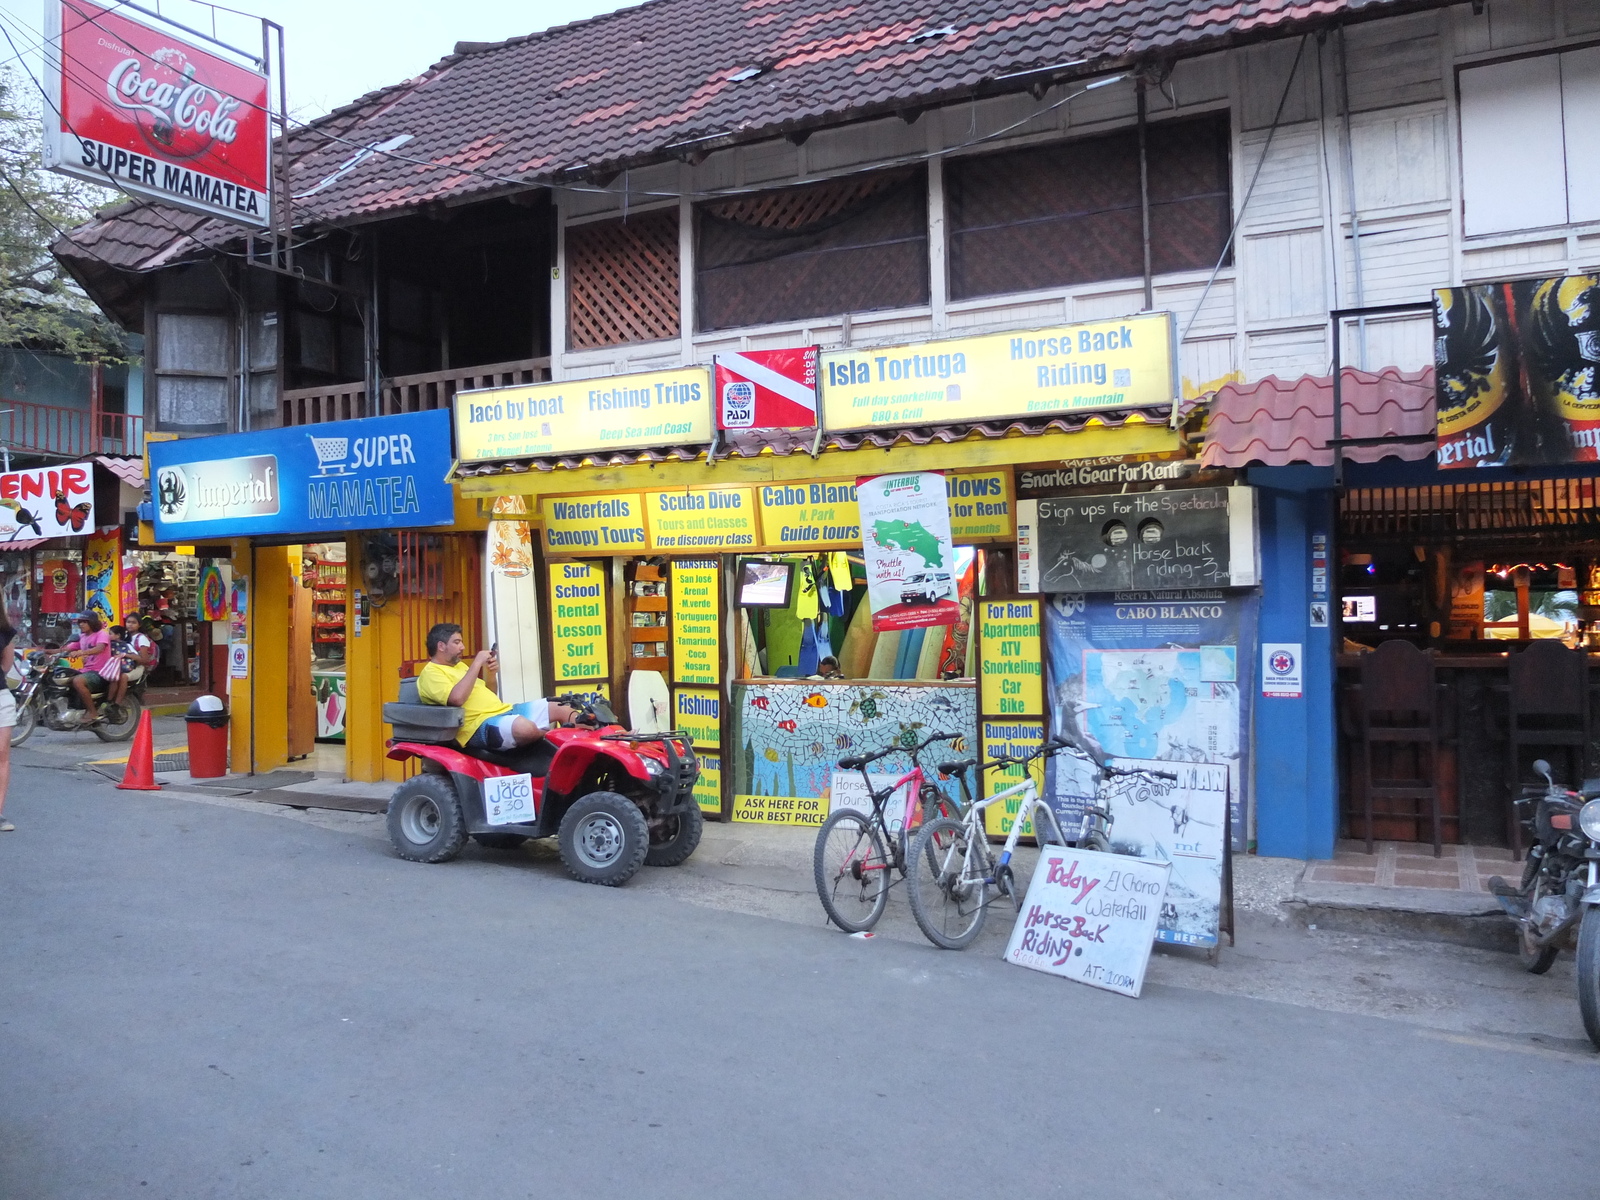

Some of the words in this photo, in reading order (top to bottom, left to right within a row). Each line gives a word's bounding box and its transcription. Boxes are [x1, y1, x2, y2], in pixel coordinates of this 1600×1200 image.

[107, 58, 241, 144] Coca-Cola
[81, 140, 157, 186] SUPER
[163, 165, 258, 215] MAMATEA
[1010, 334, 1071, 360] Horse
[1077, 325, 1132, 354] Back
[829, 360, 869, 386] Isla
[875, 352, 966, 382] Tortuga
[1037, 362, 1107, 388] Riding
[588, 386, 650, 411] Fishing
[654, 381, 701, 405] Trips
[852, 395, 869, 407] Full
[871, 395, 889, 406] day
[891, 390, 943, 404] snorkeling
[1026, 399, 1059, 412] Beach
[1072, 391, 1124, 408] Mountain
[469, 399, 502, 423] Jacó
[507, 399, 524, 421] by
[528, 395, 564, 416] boat
[727, 409, 750, 420] PADI
[872, 410, 890, 422] BBQ
[902, 408, 923, 420] Grill
[600, 428, 623, 441] Deep
[625, 426, 642, 438] Sea
[644, 423, 662, 436] and
[664, 421, 692, 435] Coast
[350, 433, 416, 469] SUPER
[886, 476, 920, 489] INTERBUS
[1021, 467, 1077, 489] Snorkel
[1079, 467, 1117, 485] Gear
[1139, 461, 1182, 480] Rent
[193, 466, 273, 517] Imperial
[309, 475, 420, 519] MAMATEA
[763, 485, 805, 507] Cabo
[809, 482, 858, 504] Blanc
[660, 493, 705, 511] Scuba
[708, 491, 742, 509] Dive
[553, 499, 630, 520] Waterfalls
[799, 510, 808, 521] N.
[811, 508, 835, 521] Park
[954, 503, 973, 517] for
[975, 501, 1008, 517] Rent
[1039, 502, 1074, 526] Sign
[1081, 503, 1106, 522] ups
[1134, 496, 1158, 512] the
[657, 518, 684, 531] Tours
[687, 517, 705, 530] and
[707, 517, 747, 529] Classes
[965, 523, 1000, 535] months
[547, 529, 598, 547] Canopy
[600, 526, 645, 544] Tours
[657, 535, 675, 546] free
[677, 534, 724, 547] discovery
[726, 533, 753, 545] class
[780, 526, 820, 542] Guide
[822, 525, 859, 540] tours
[1133, 543, 1171, 564] Horse
[1175, 540, 1211, 557] back
[564, 564, 590, 578] Surf
[674, 560, 718, 569] TRANSFERS
[876, 558, 902, 571] Shuttle
[680, 575, 694, 583] San
[695, 574, 712, 583] José
[875, 568, 893, 579] with
[555, 583, 600, 598] School
[684, 587, 708, 596] Arenal
[1113, 590, 1147, 600] Reserva
[1149, 590, 1182, 600] Natural
[1183, 589, 1223, 600] Absoluta
[557, 603, 600, 618] Rental
[682, 599, 711, 608] M.verde
[987, 603, 1004, 618] For
[1006, 603, 1033, 618] Rent
[676, 612, 717, 621] Tortuguero
[1116, 607, 1157, 620] CABO
[1160, 605, 1222, 619] BLANCO
[556, 625, 602, 638] Lesson
[682, 624, 711, 634] Sámara
[983, 622, 1041, 639] Apartment
[677, 637, 717, 646] Tamarindo
[1001, 640, 1021, 656] ATV
[567, 642, 594, 657] Surf
[688, 649, 707, 658] Coco
[562, 662, 600, 677] Safari
[684, 661, 711, 671] Nosara
[983, 660, 1041, 676] Snorkeling
[681, 674, 695, 683] and
[696, 675, 715, 683] more
[1002, 679, 1021, 694] Car
[678, 693, 719, 719] Fishing
[1000, 698, 1025, 713] Bike
[985, 723, 1043, 741] Bungalows
[987, 742, 1006, 757] and
[702, 755, 721, 770] Tours
[707, 779, 717, 788] and
[836, 776, 868, 791] Horses
[504, 799, 523, 811] 30
[744, 798, 766, 808] ASK
[768, 799, 794, 809] HERE
[797, 800, 818, 810] FOR
[836, 792, 868, 806] Tours
[735, 809, 766, 821] YOUR
[768, 810, 793, 822] BEST
[795, 812, 825, 824] PRICE
[1046, 858, 1100, 905] Today
[1122, 873, 1160, 895] Chorro
[1085, 898, 1147, 920] Waterfall
